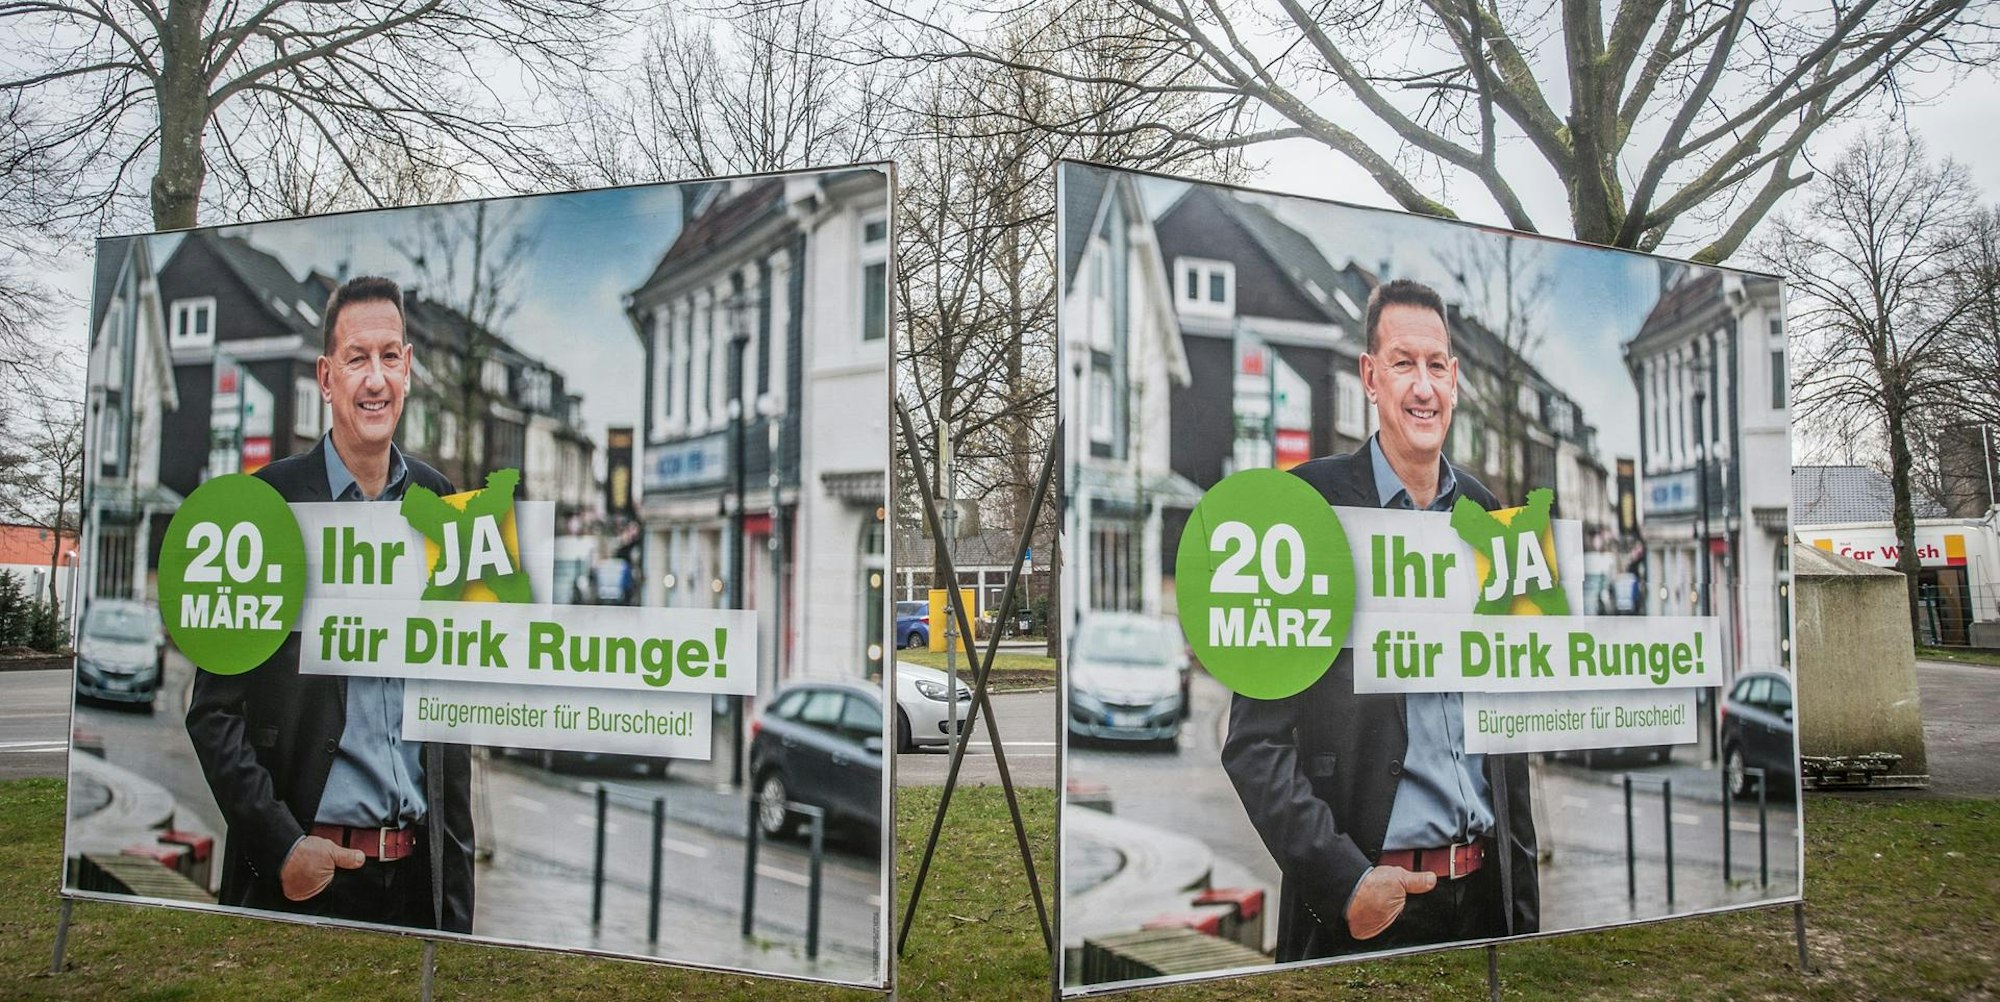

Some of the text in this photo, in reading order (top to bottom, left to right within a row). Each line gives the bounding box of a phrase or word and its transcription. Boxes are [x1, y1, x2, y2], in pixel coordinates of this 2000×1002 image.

[184, 521, 282, 582] 20.
[322, 515, 514, 587] Ihr JA
[1209, 521, 1329, 595] 20.
[1371, 530, 1553, 602] Ihr JA
[1881, 544, 1940, 560] Wsh
[180, 586, 283, 630] MÄRZ
[1209, 598, 1332, 647] MÄRZ
[319, 616, 728, 687] für Dirk Runge!
[1372, 631, 1705, 685] für Dirk Runge!
[418, 697, 694, 737] Bürgermeister für Burscheid!
[1478, 704, 1686, 738] Bürgermeister für Burscheid!
